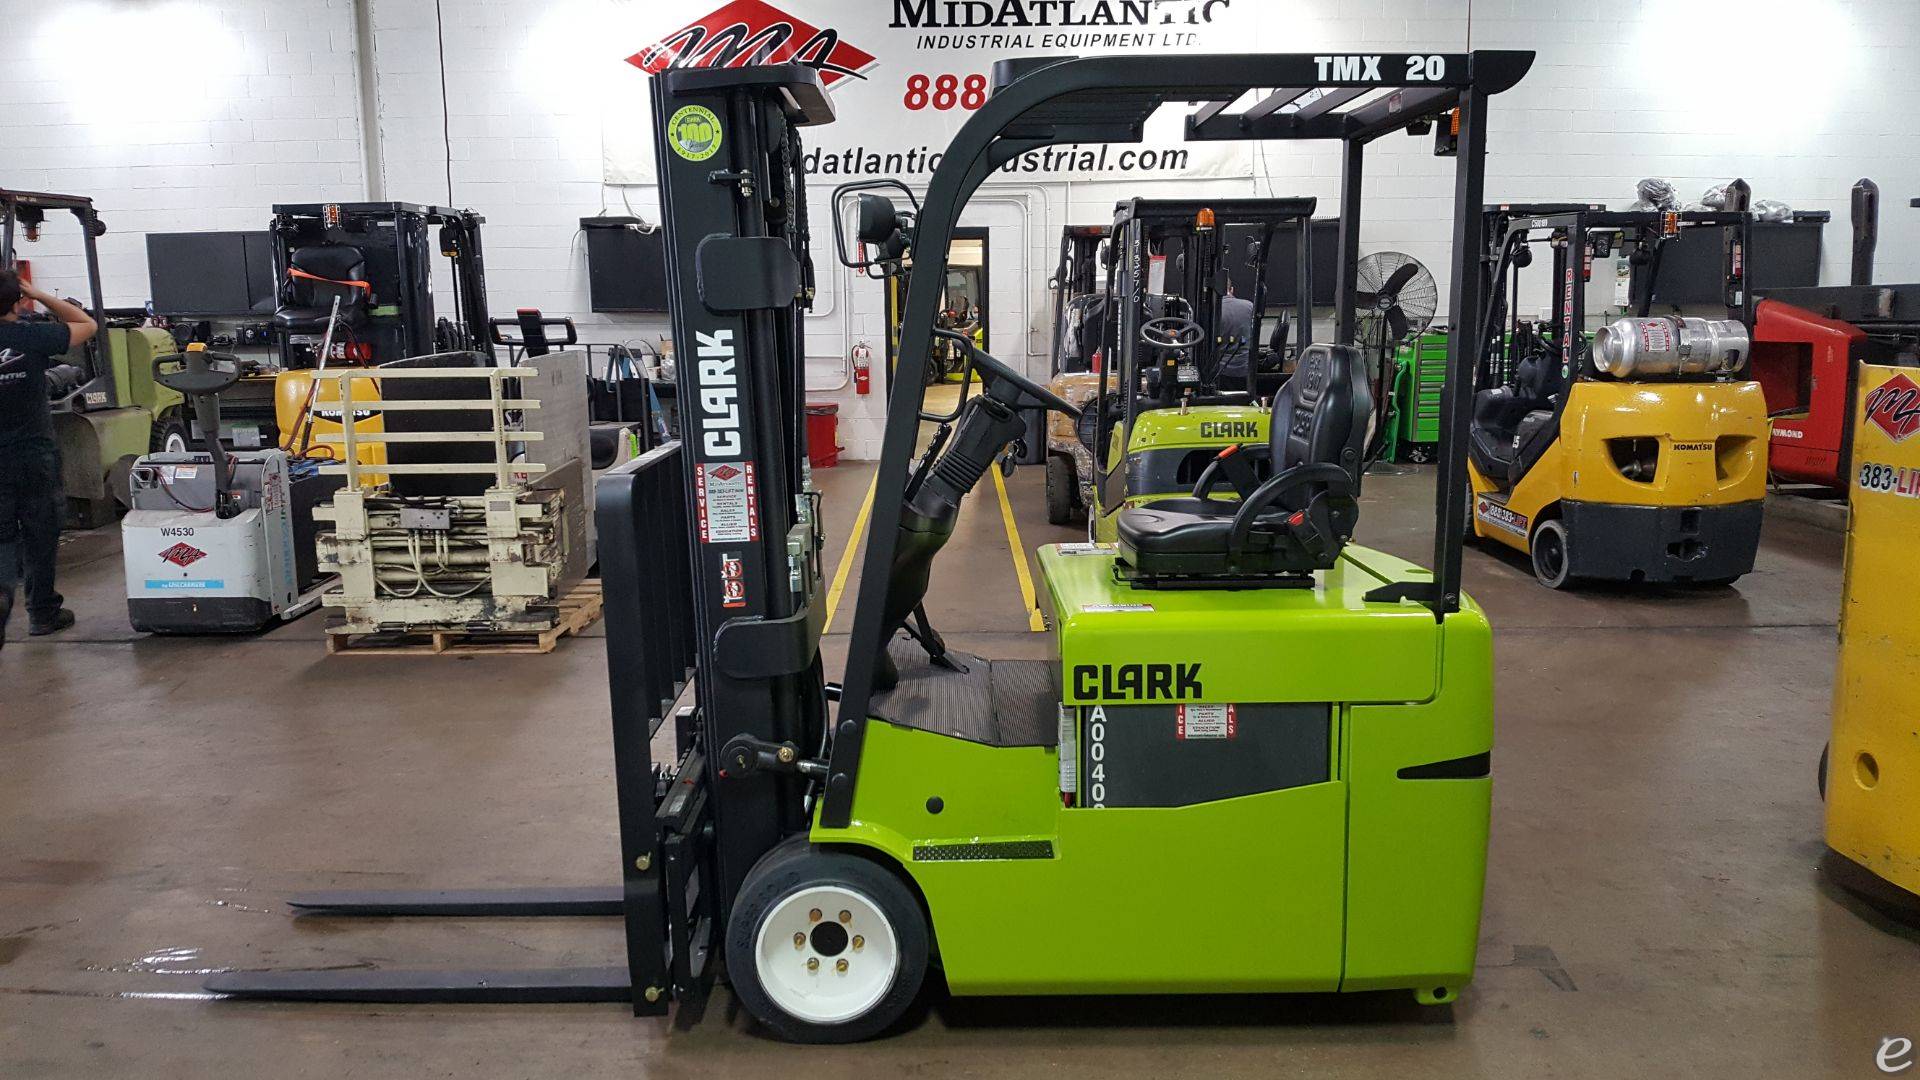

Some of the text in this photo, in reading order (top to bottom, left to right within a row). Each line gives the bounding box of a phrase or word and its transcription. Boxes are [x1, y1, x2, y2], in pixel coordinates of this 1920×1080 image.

[916, 34, 1035, 49] INDUSTRIAL
[1041, 33, 1156, 48] EQUIPMENT
[1313, 55, 1446, 81] TMX 20
[672, 106, 715, 125] CENTENNIAL
[1562, 268, 1573, 363] RENTAL
[694, 329, 742, 457] CLARK
[1200, 421, 1258, 438] CLARK
[1673, 443, 1713, 451] KOMATSU
[696, 466, 708, 539] SERVICE
[746, 465, 757, 537] RENTALS
[160, 527, 195, 537] W4530
[1073, 663, 1203, 701] CLARK
[1089, 705, 1107, 809] A0040
